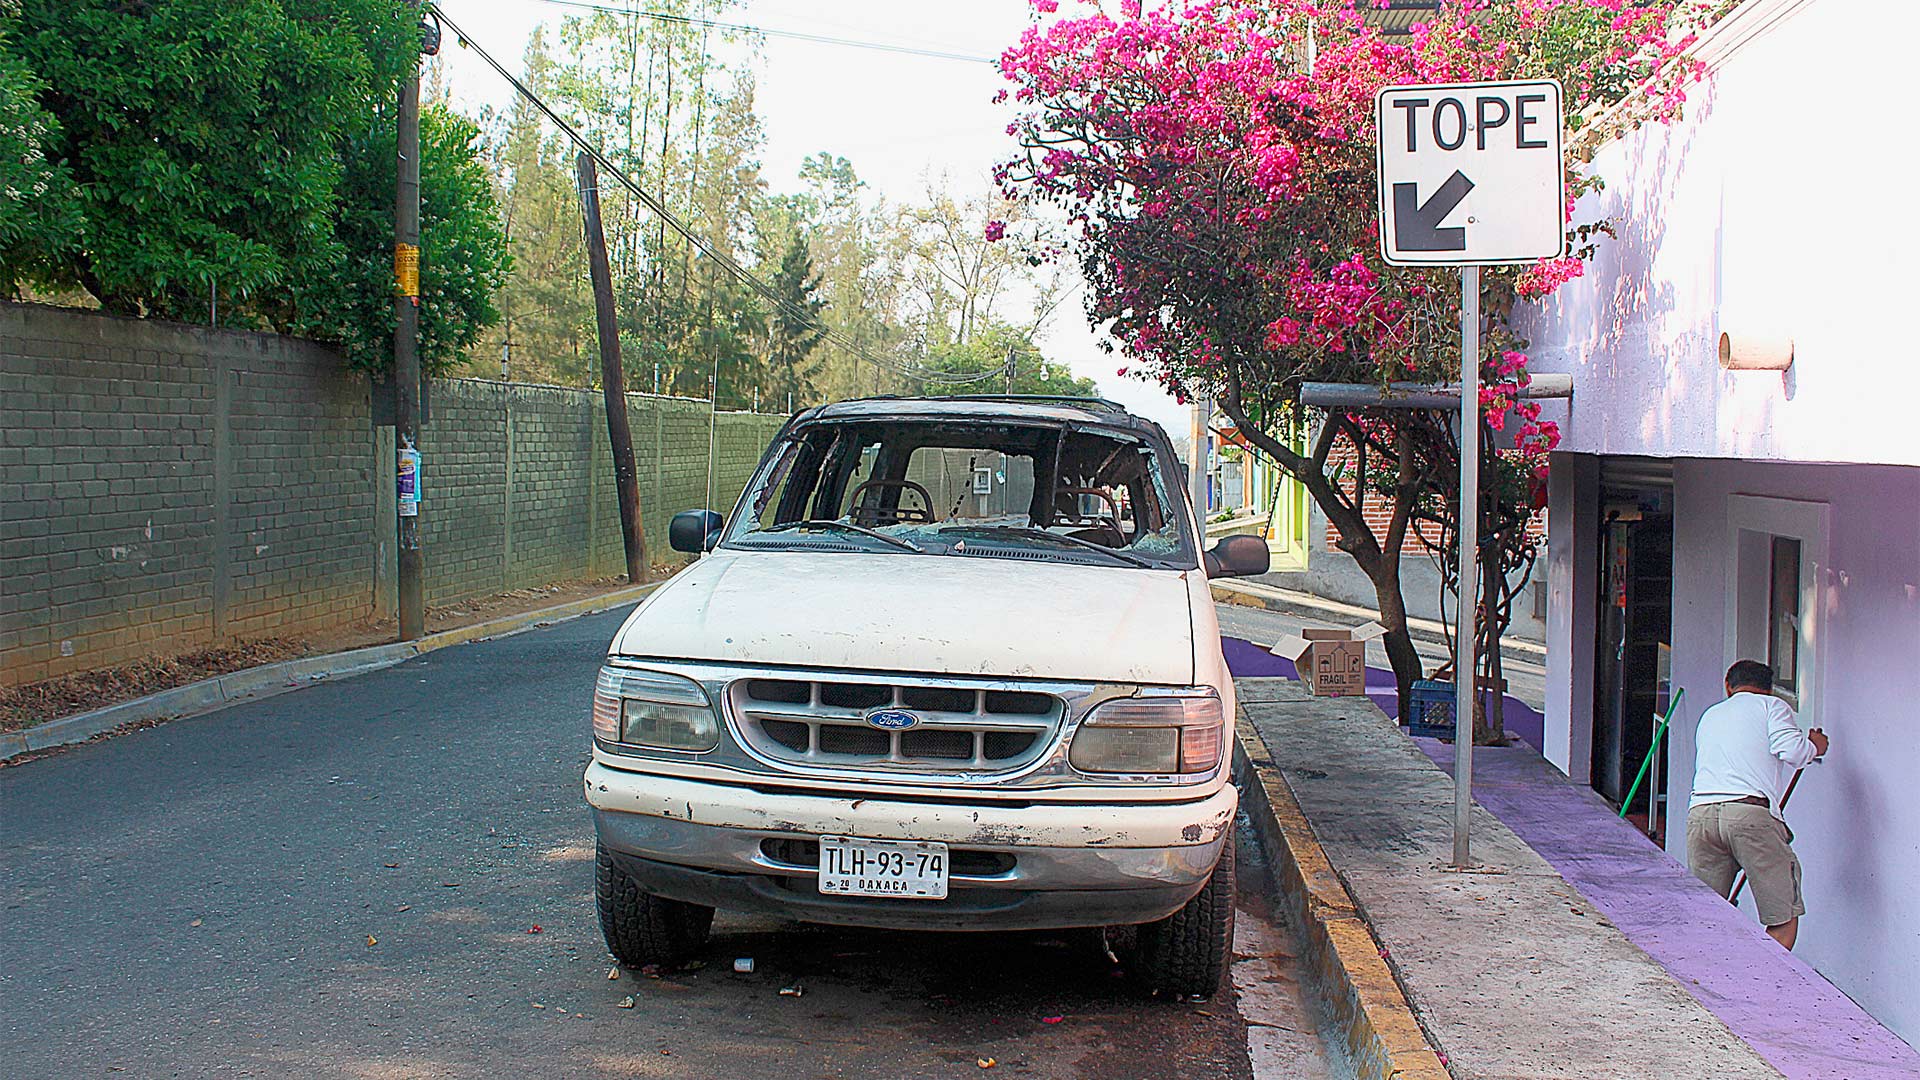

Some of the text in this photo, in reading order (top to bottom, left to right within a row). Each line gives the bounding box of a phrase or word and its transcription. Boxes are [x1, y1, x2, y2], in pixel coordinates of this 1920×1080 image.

[1393, 94, 1548, 152] TOPE
[1319, 674, 1346, 684] FRAGIL
[878, 713, 905, 726] Ford
[825, 847, 943, 878] TLH-93-74
[840, 879, 908, 891] 20 OAXACA
